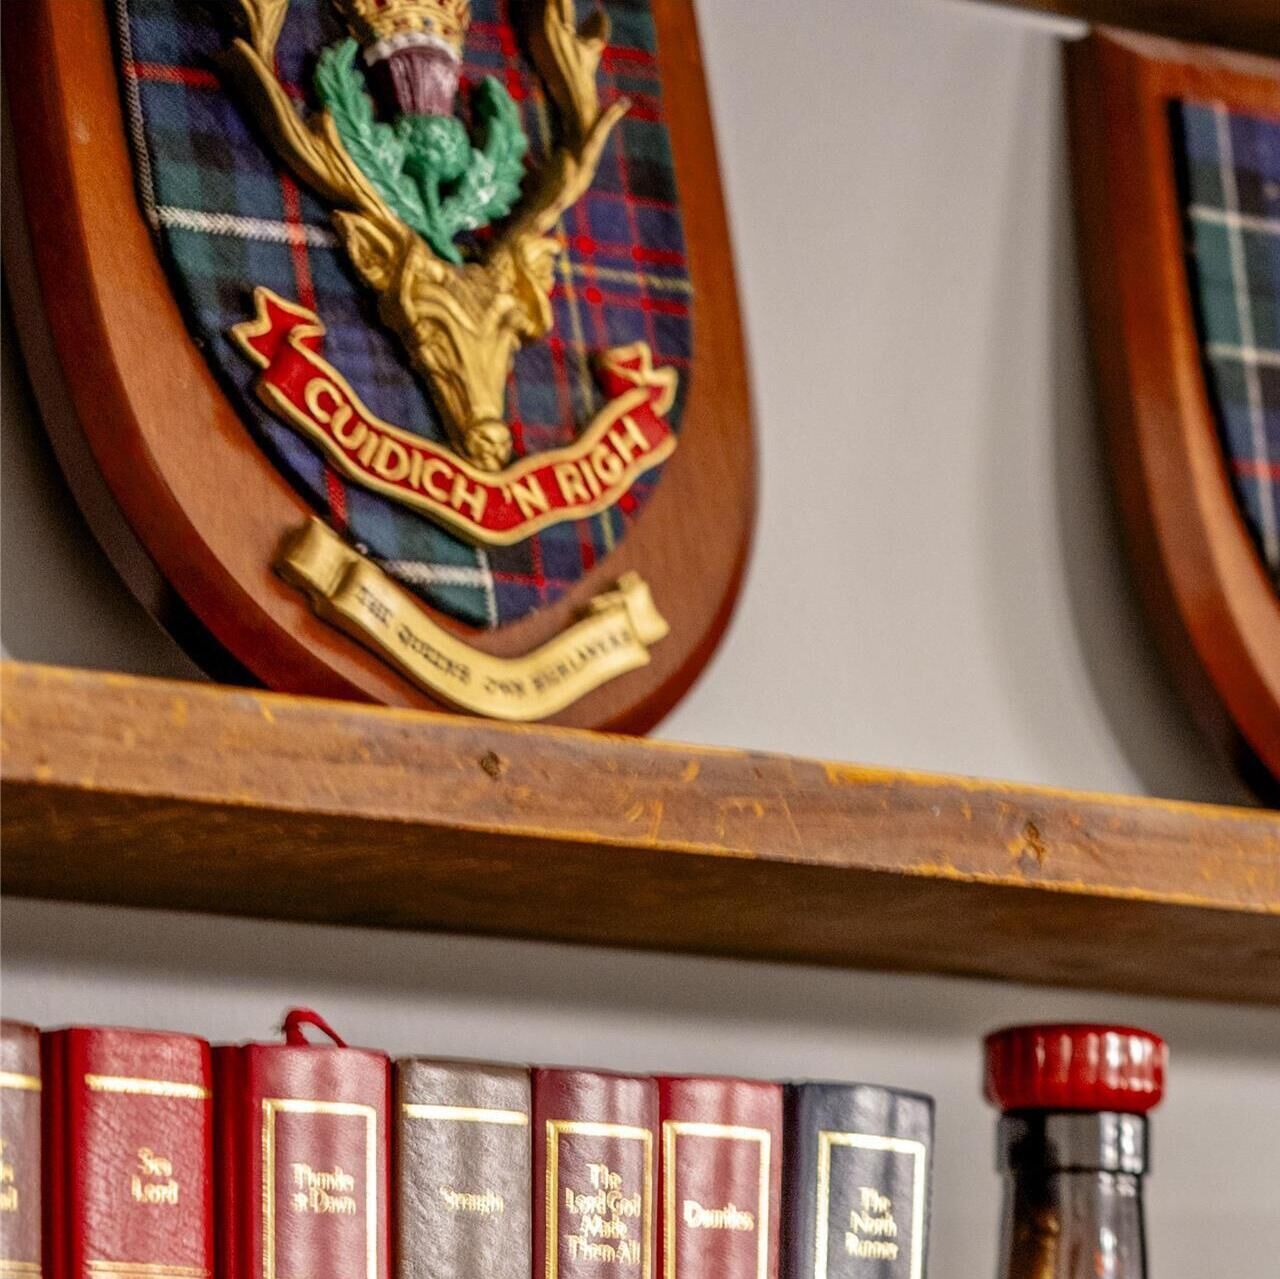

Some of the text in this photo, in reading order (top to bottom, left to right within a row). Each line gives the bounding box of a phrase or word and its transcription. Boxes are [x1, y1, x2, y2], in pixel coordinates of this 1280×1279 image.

[304, 377, 651, 523] CUIDICH 'N RIGH
[131, 1175, 179, 1205] Lord
[586, 1163, 622, 1190] The
[309, 1187, 357, 1215] Dawn
[565, 1187, 642, 1217] Lord God
[858, 1186, 892, 1214] The
[850, 1209, 898, 1238] North
[564, 1234, 641, 1265] Them All
